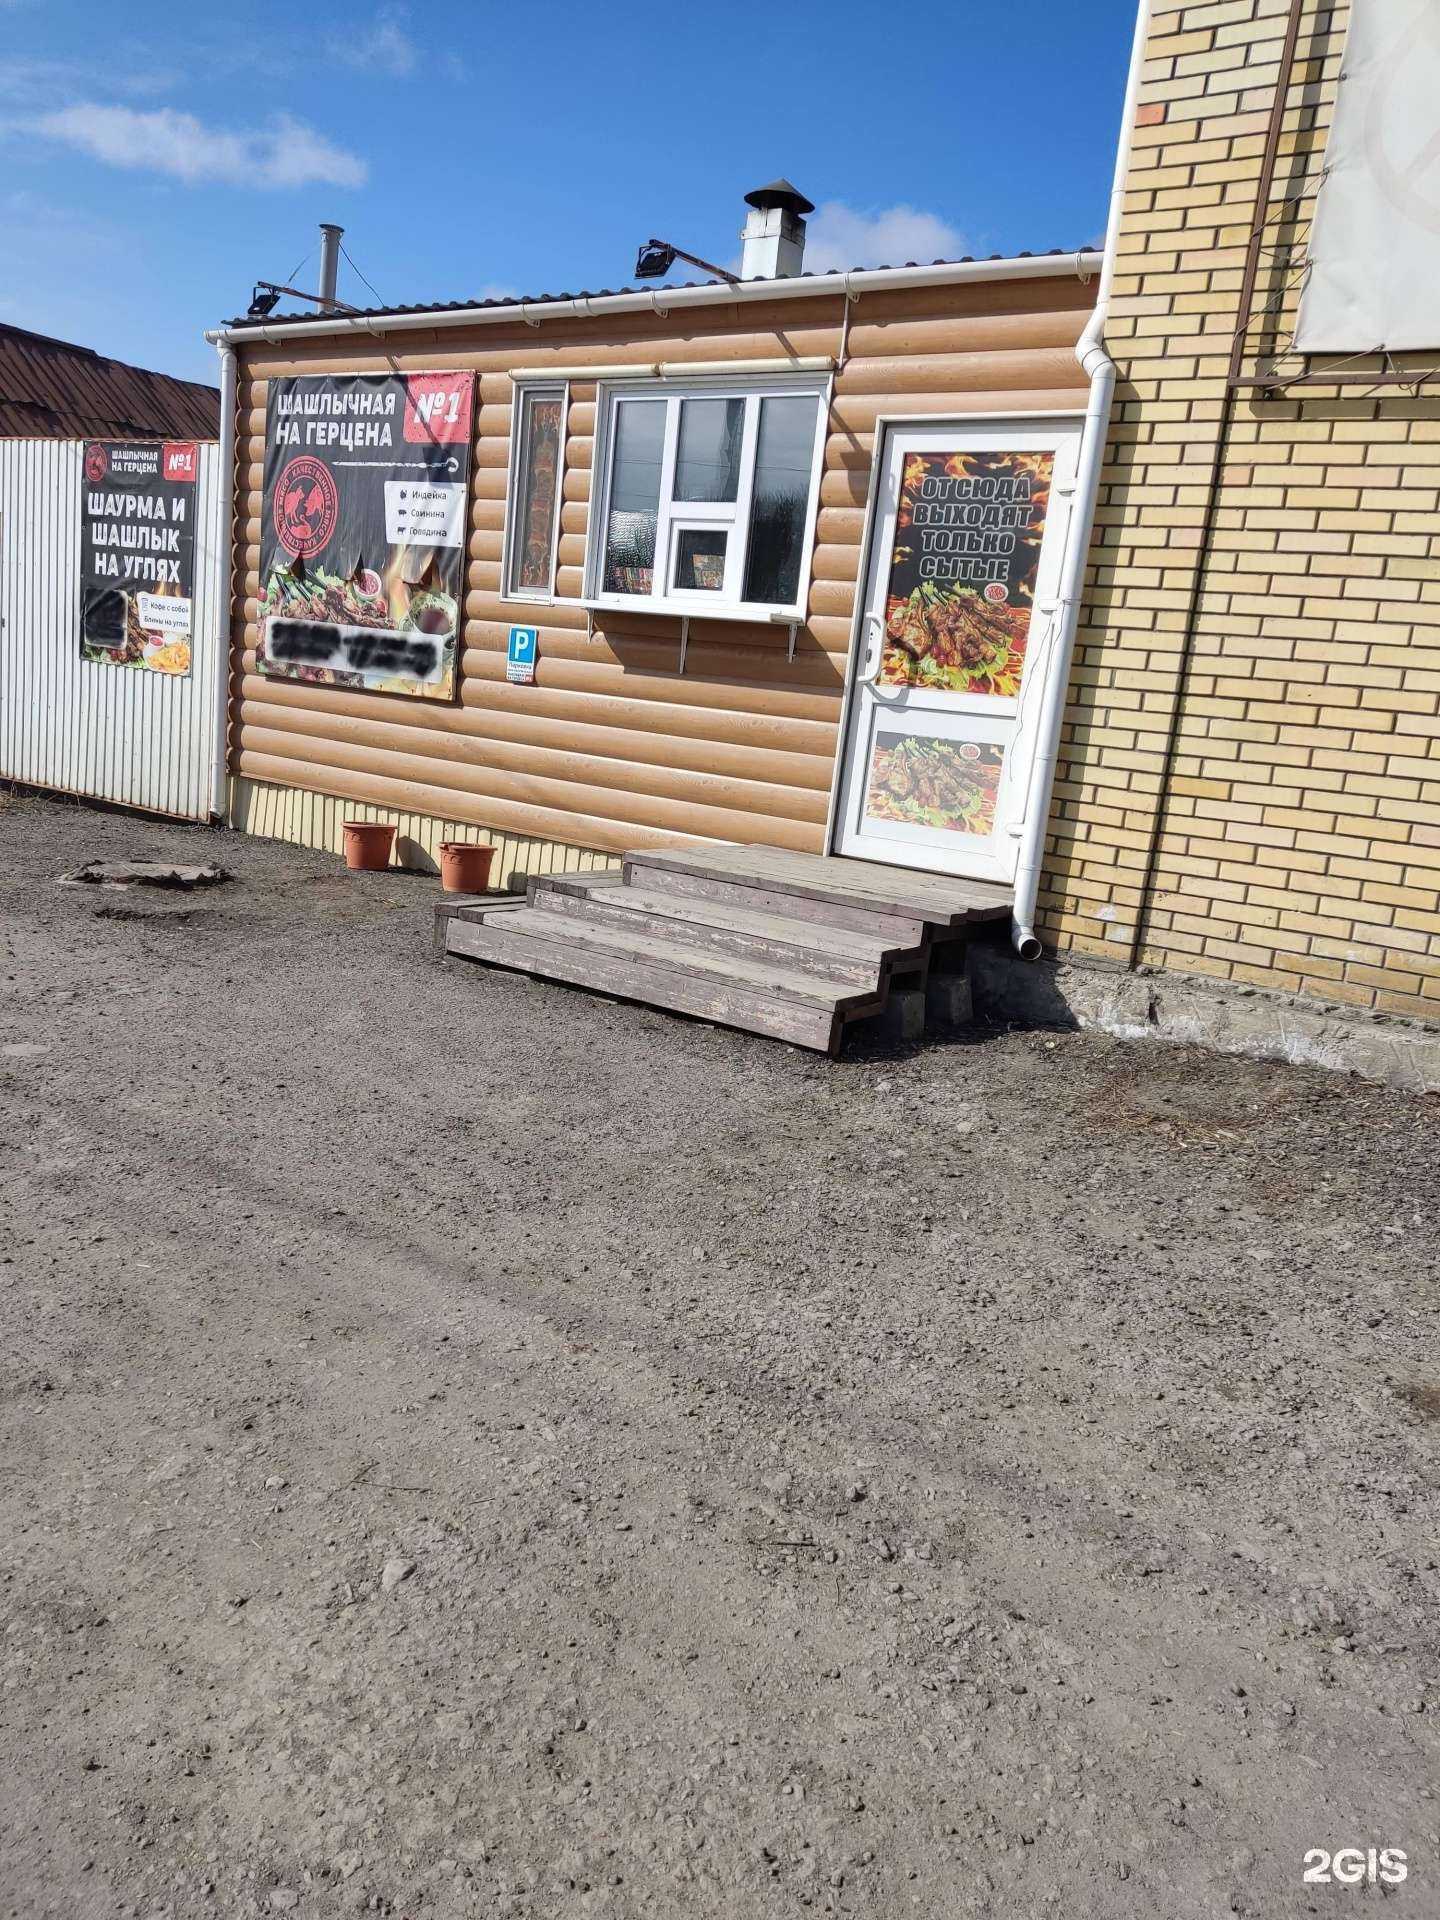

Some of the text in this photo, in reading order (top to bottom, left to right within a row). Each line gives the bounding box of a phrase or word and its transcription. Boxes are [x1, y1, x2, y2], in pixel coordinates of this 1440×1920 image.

[278, 393, 396, 416] ШАШЛЫЧНАЯ
[413, 391, 461, 424] №1
[275, 422, 393, 452] НА ГЕРЦЕНА
[111, 450, 158, 461] ШАШЛЫЧНАЯ
[111, 461, 158, 474] НА ГЕРЦЕНА
[168, 454, 192, 471] №1
[88, 492, 185, 521] ШАУРМА И
[412, 489, 447, 500] Индейка
[913, 503, 1034, 530] ВЫХОДЯТ
[92, 522, 180, 552] ШАШЛЫК
[921, 529, 1016, 555] ТОЛЬКО
[94, 552, 181, 583] НА УГЛЯХ
[919, 556, 1010, 581] СЫТЫЕ
[514, 631, 529, 659] P
